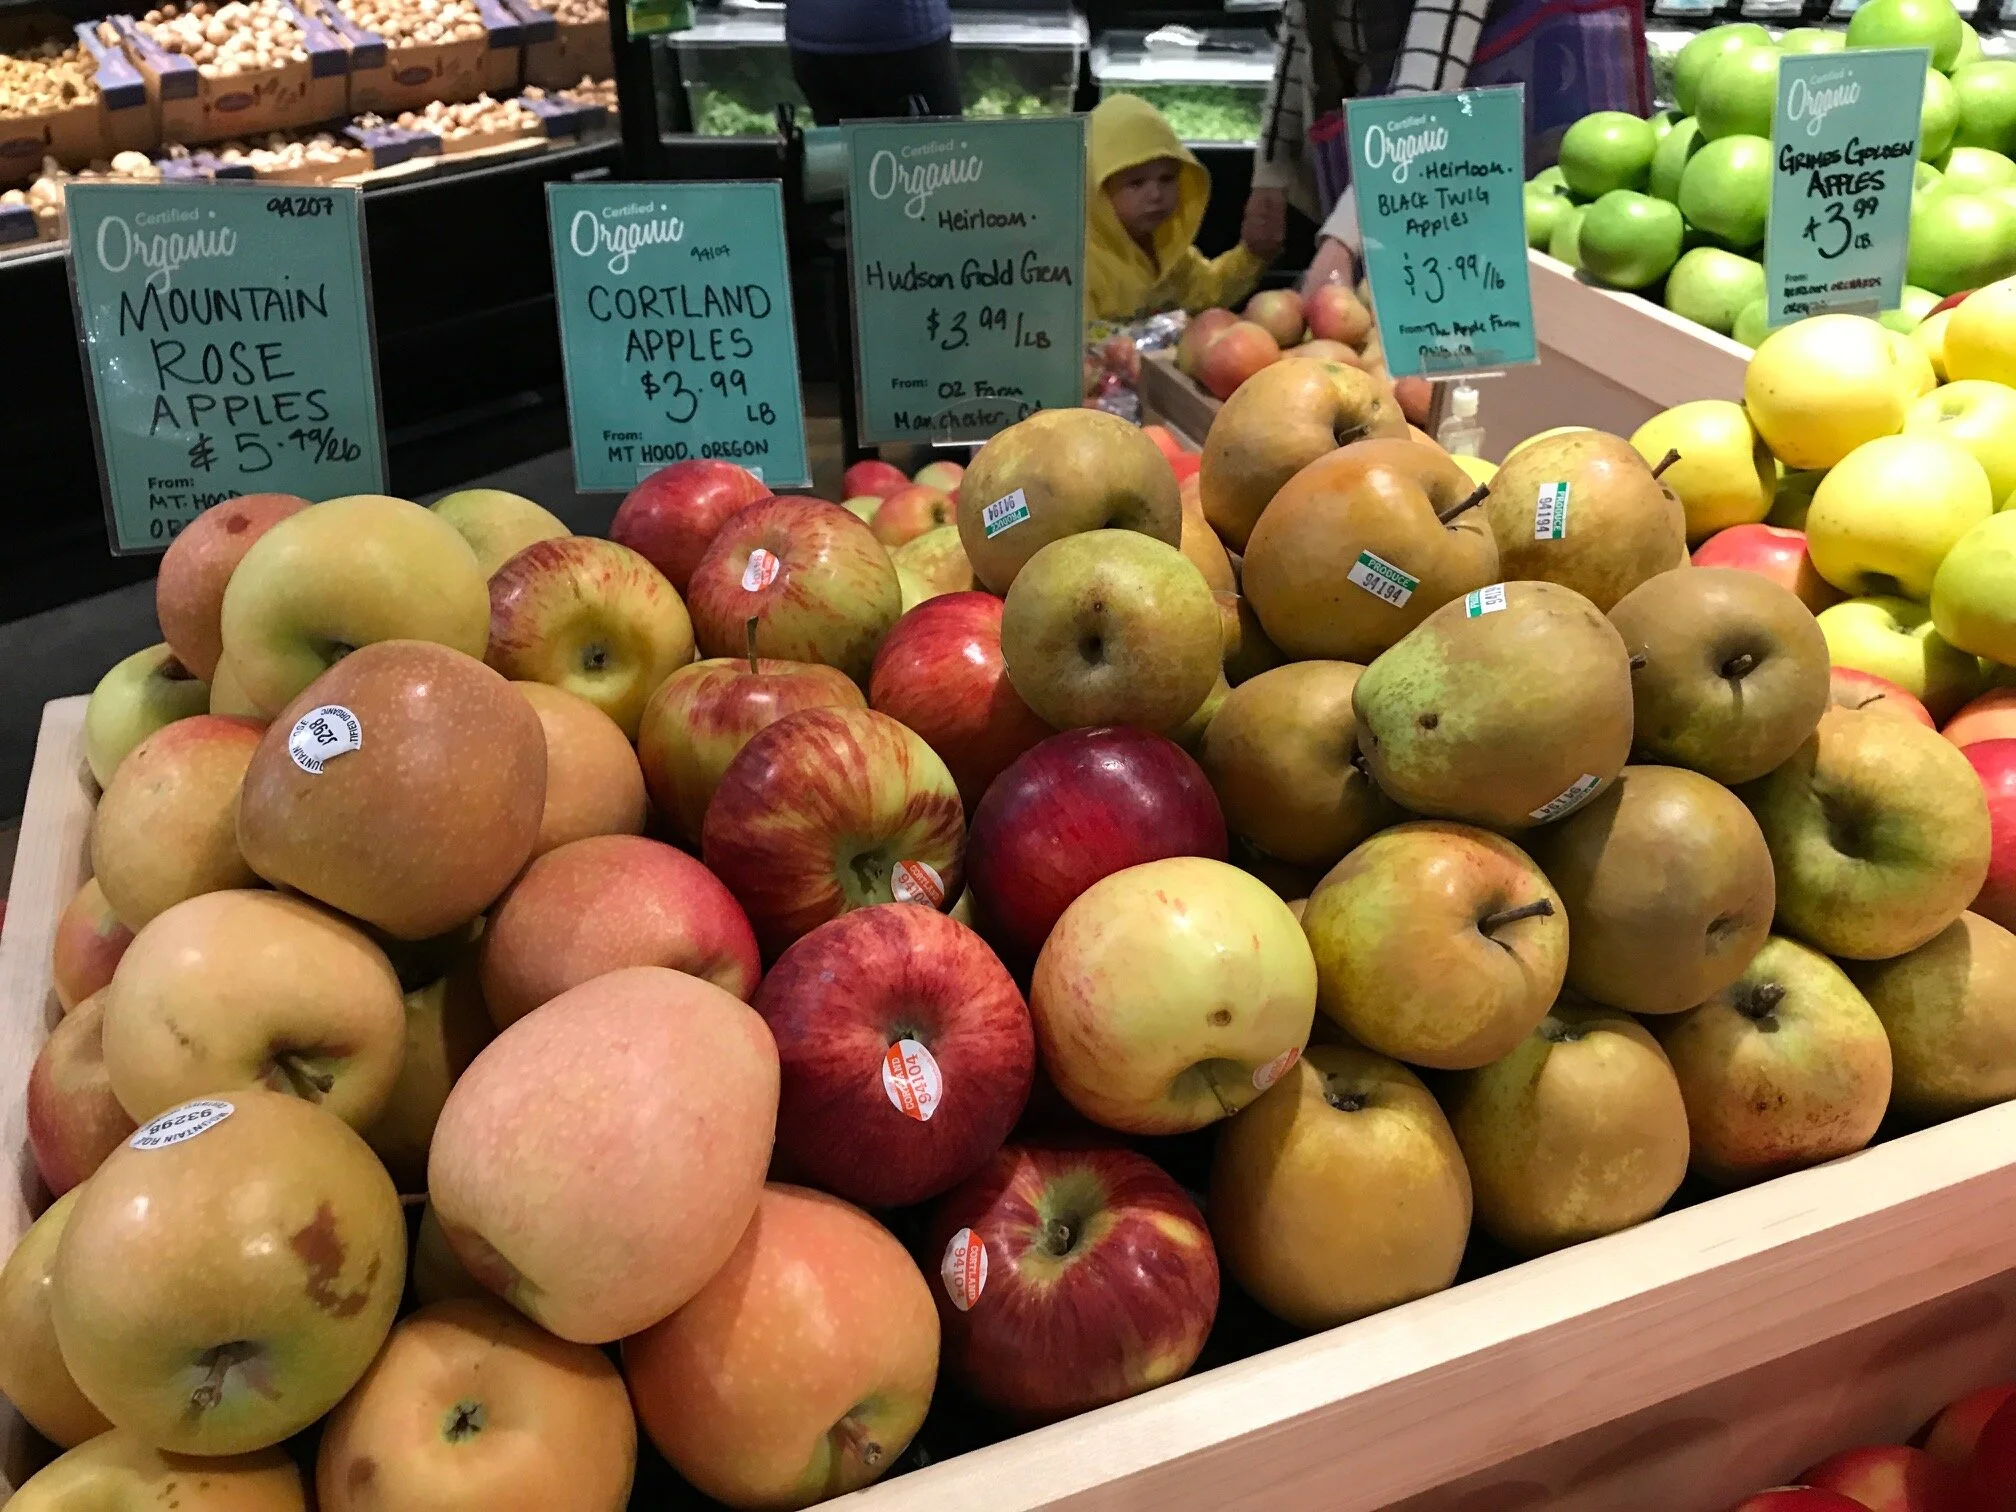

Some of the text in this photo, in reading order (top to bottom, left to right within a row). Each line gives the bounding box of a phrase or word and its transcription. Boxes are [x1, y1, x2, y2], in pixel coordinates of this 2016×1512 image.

[1787, 78, 1861, 136] Organic
[901, 139, 954, 158] Certified
[1364, 125, 1449, 183] Organic
[1844, 137, 1915, 166] GOLDEN
[869, 150, 983, 219] Organic
[1806, 169, 1885, 199] APPLES
[602, 201, 654, 219] Certified
[1378, 186, 1490, 217] BLACK TWIG
[135, 209, 199, 226] Certified
[1406, 212, 1469, 237] Apples
[97, 216, 236, 294] Organic
[571, 210, 684, 275] Organic
[867, 250, 1072, 291] Hudson Gold Gem
[120, 282, 328, 336] MOUNTAIN
[588, 284, 771, 322] CORTLAND
[625, 327, 753, 363] APPLES
[151, 338, 295, 390] ROSE
[891, 378, 928, 389] From:
[150, 388, 330, 435] APPLES
[747, 402, 776, 426] LB
[603, 430, 643, 441] From:
[608, 446, 634, 462] MT
[701, 439, 768, 459] OREGON
[148, 477, 194, 490] From:
[149, 493, 187, 510] MT.
[1554, 491, 1565, 531] PRODUCE
[991, 510, 1021, 532] PRODUCE
[1368, 559, 1409, 587] PRODUCE
[321, 708, 351, 721] ORGANIC
[910, 864, 939, 900] CORTLAND
[906, 1053, 931, 1104] 94104
[149, 1108, 212, 1135] 93298
[968, 1245, 979, 1300] CORTLAND
